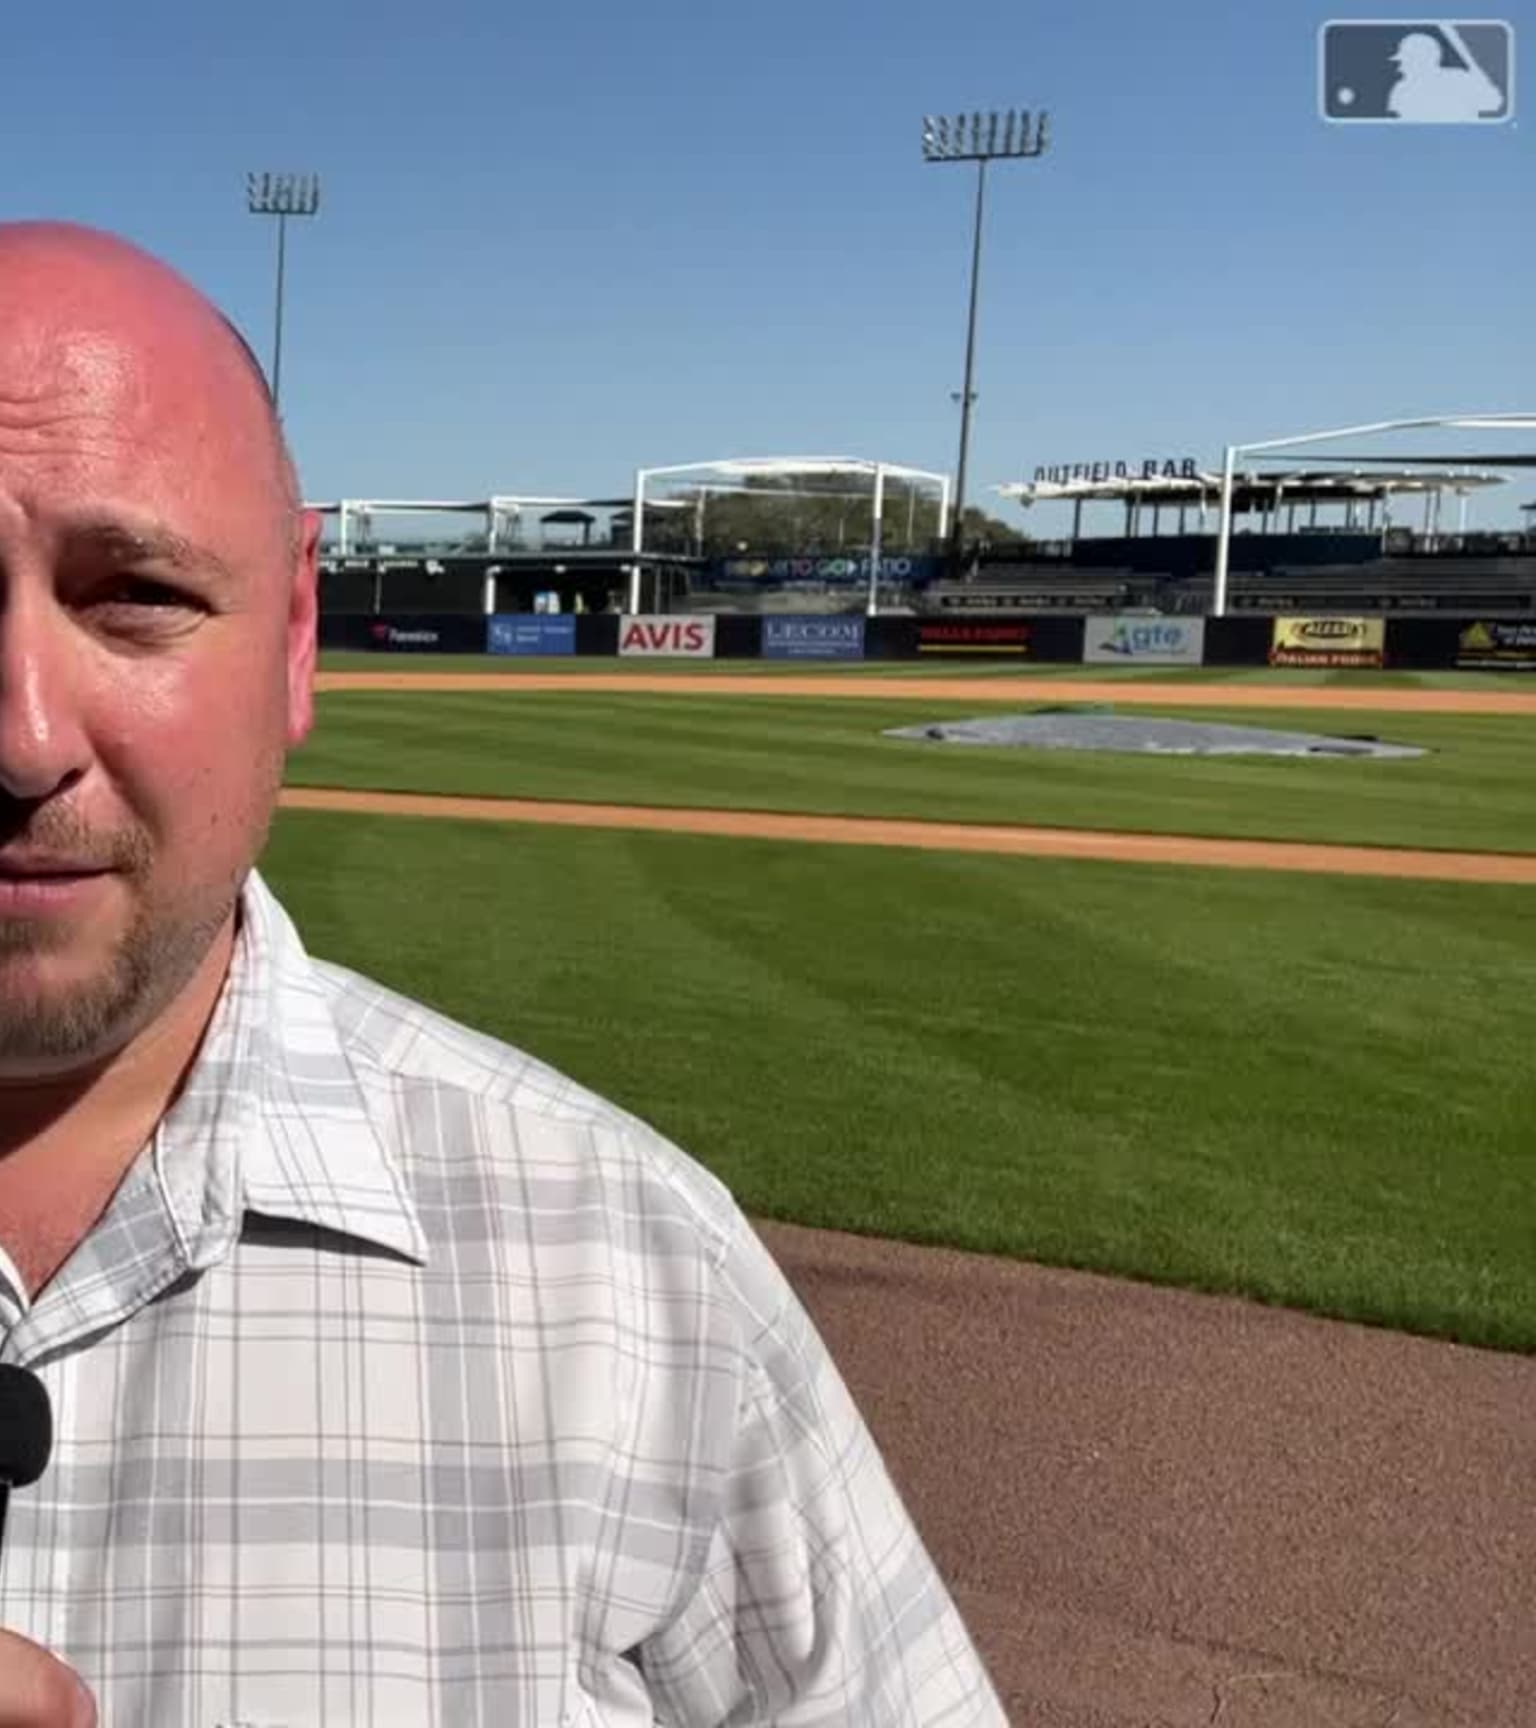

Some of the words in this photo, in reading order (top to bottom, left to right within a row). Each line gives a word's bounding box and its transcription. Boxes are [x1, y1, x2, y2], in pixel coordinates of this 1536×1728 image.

[1034, 460, 1127, 485] OUTFIELD
[1142, 458, 1195, 480] BAR
[622, 623, 705, 651] AVIS
